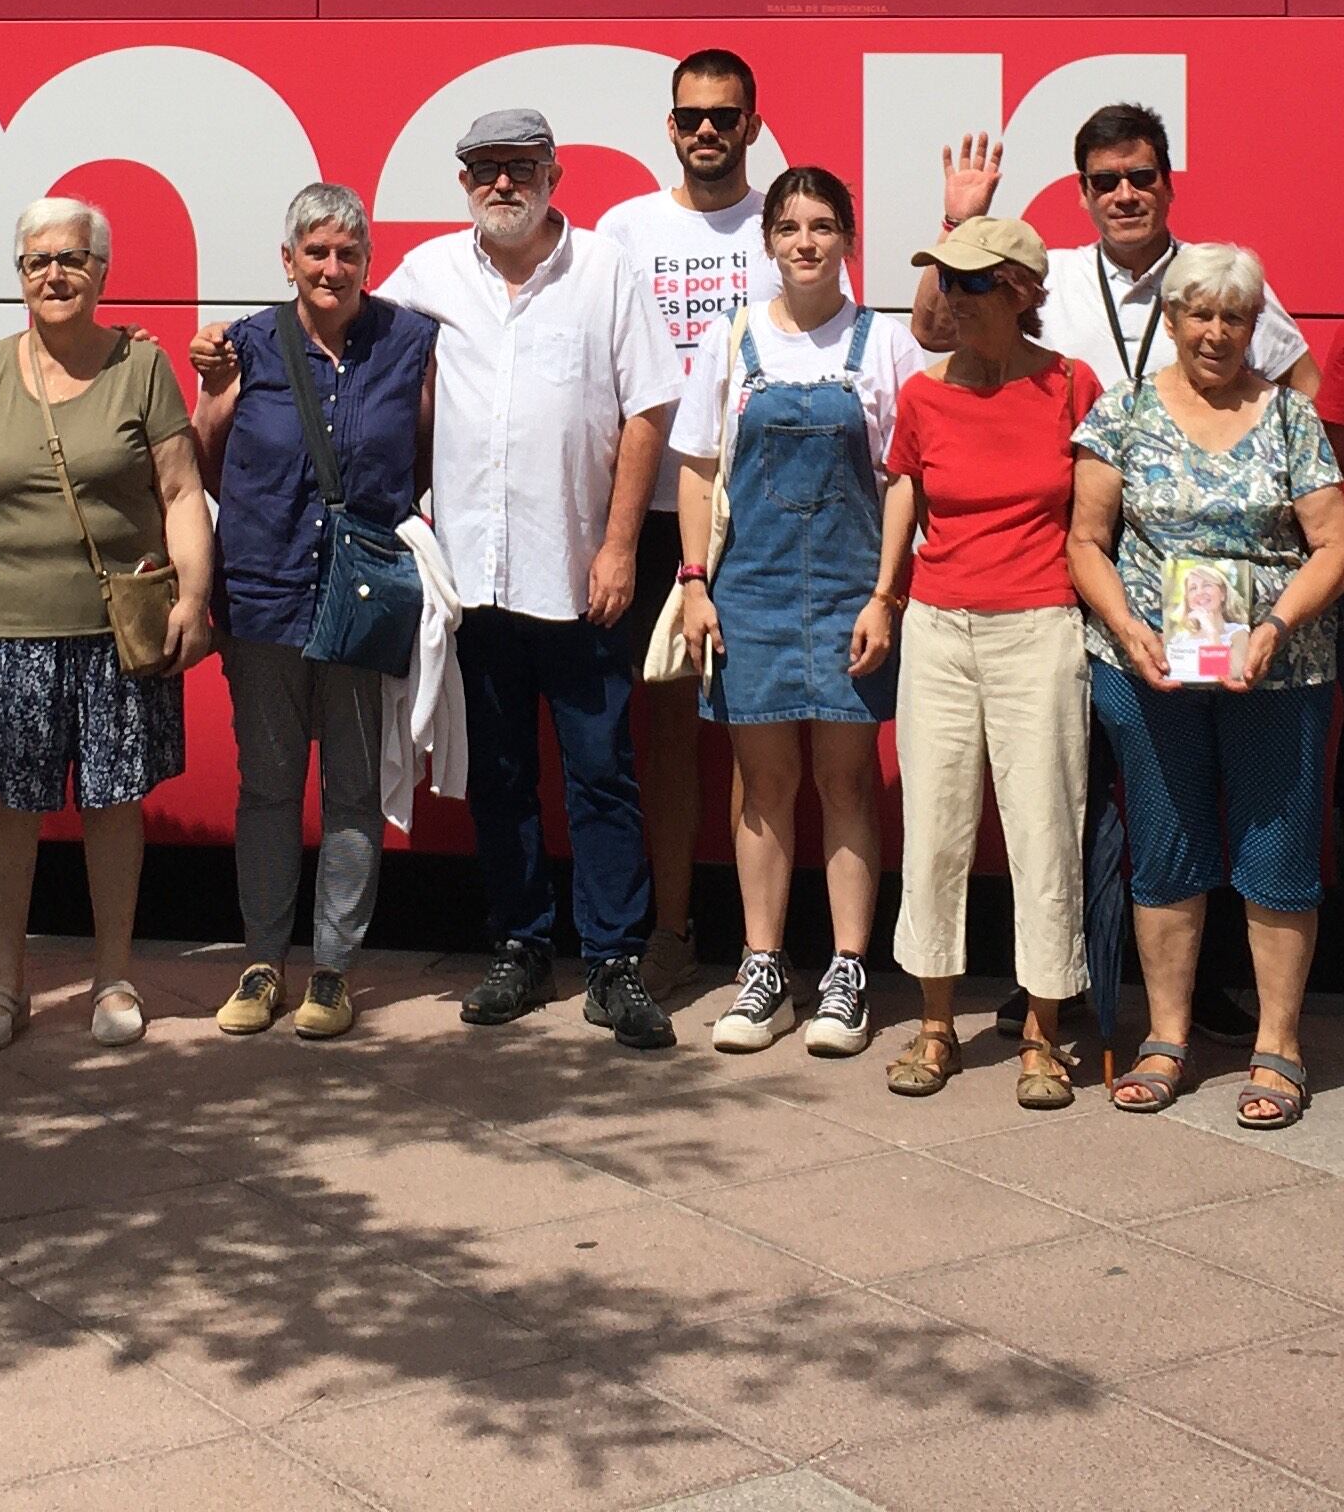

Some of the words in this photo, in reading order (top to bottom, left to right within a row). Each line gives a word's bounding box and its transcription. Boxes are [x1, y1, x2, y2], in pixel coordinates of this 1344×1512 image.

[654, 255, 680, 274] Es
[685, 255, 725, 275] por
[731, 251, 747, 268] ti
[653, 275, 679, 295] Es
[684, 275, 724, 297] por
[730, 271, 747, 290] ti
[686, 296, 725, 318] por
[731, 291, 748, 307] ti
